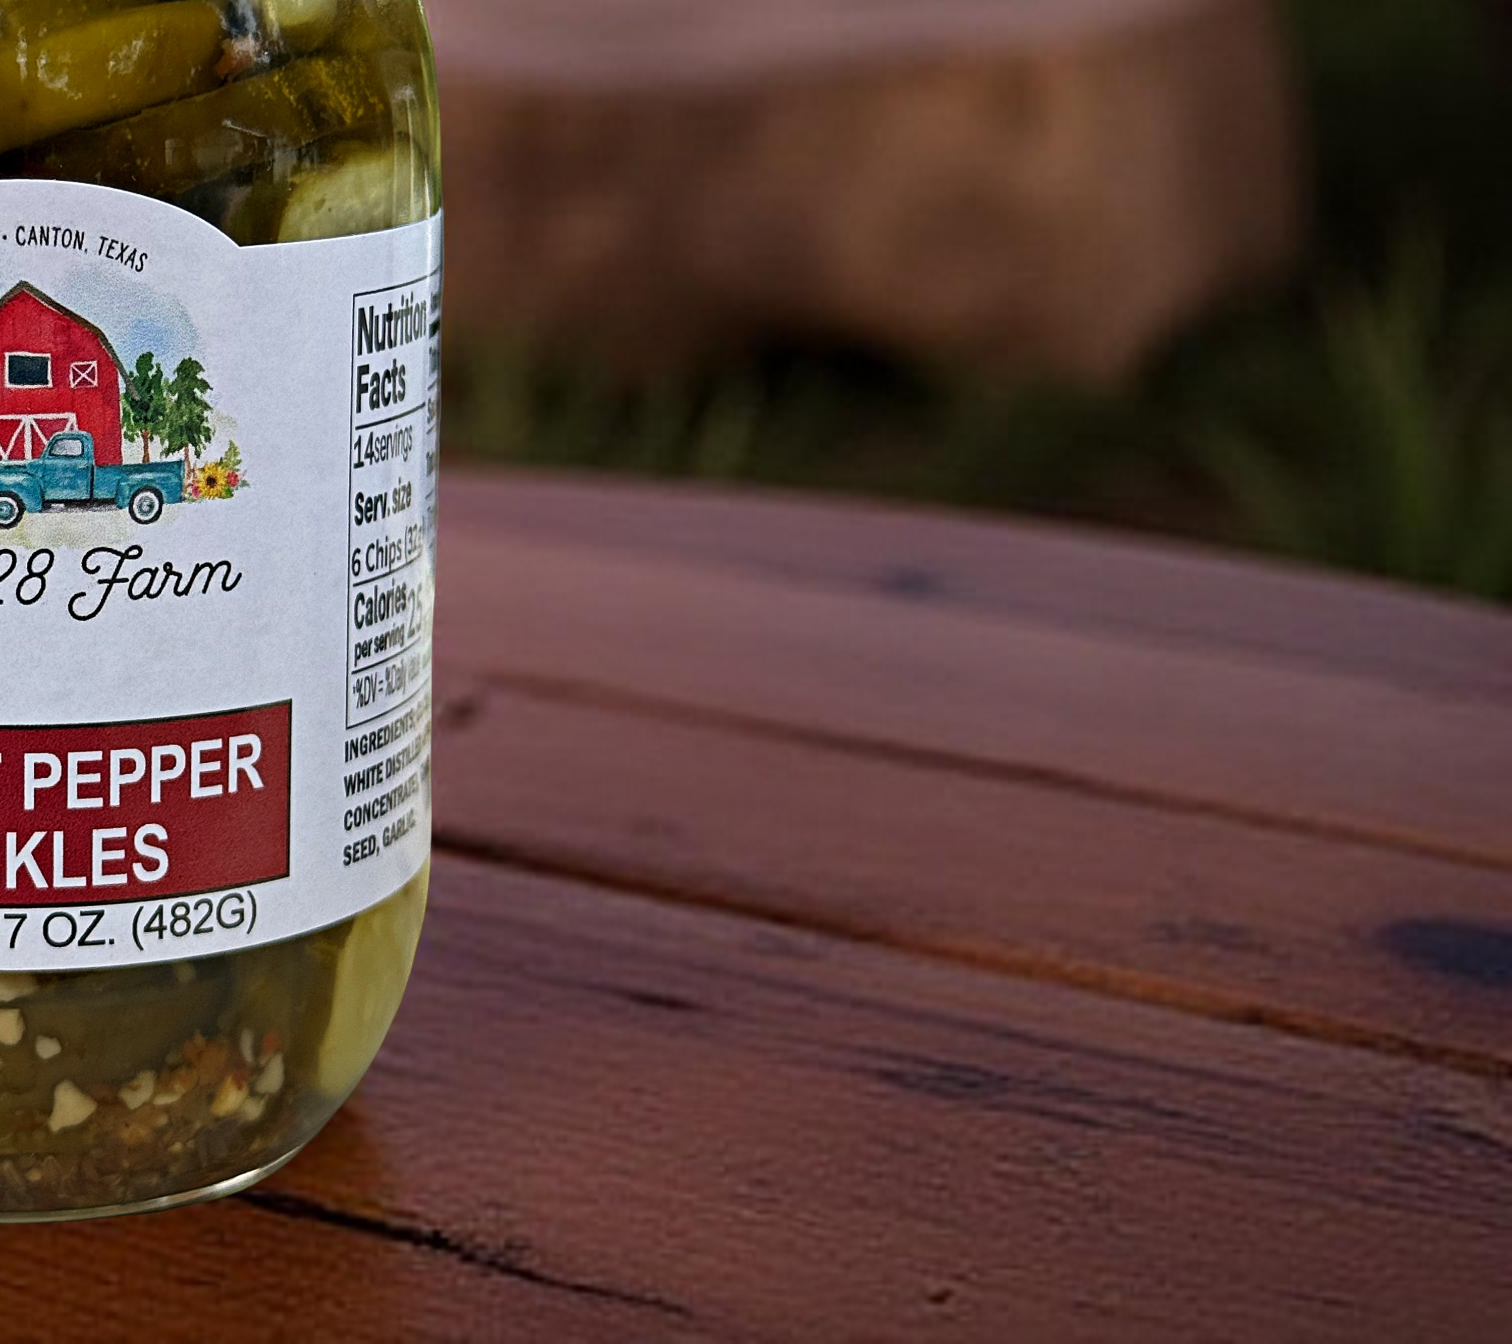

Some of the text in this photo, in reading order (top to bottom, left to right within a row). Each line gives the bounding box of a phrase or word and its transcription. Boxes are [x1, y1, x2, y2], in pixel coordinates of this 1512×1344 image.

[98, 235, 149, 273] TEXAS
[357, 291, 426, 356] Nutrition
[355, 358, 406, 413] Facts
[354, 477, 412, 526] Serv. size
[351, 547, 361, 577] 6
[365, 535, 402, 573] Chips
[67, 544, 243, 621] Farm
[354, 577, 407, 630] Calories
[354, 637, 373, 667] per
[374, 622, 404, 653] serving
[24, 732, 265, 811] PEPPER
[344, 761, 384, 798] WHITE
[343, 834, 380, 866] SEED,
[42, 908, 115, 948] OZ.
[131, 889, 258, 952] (482G)
